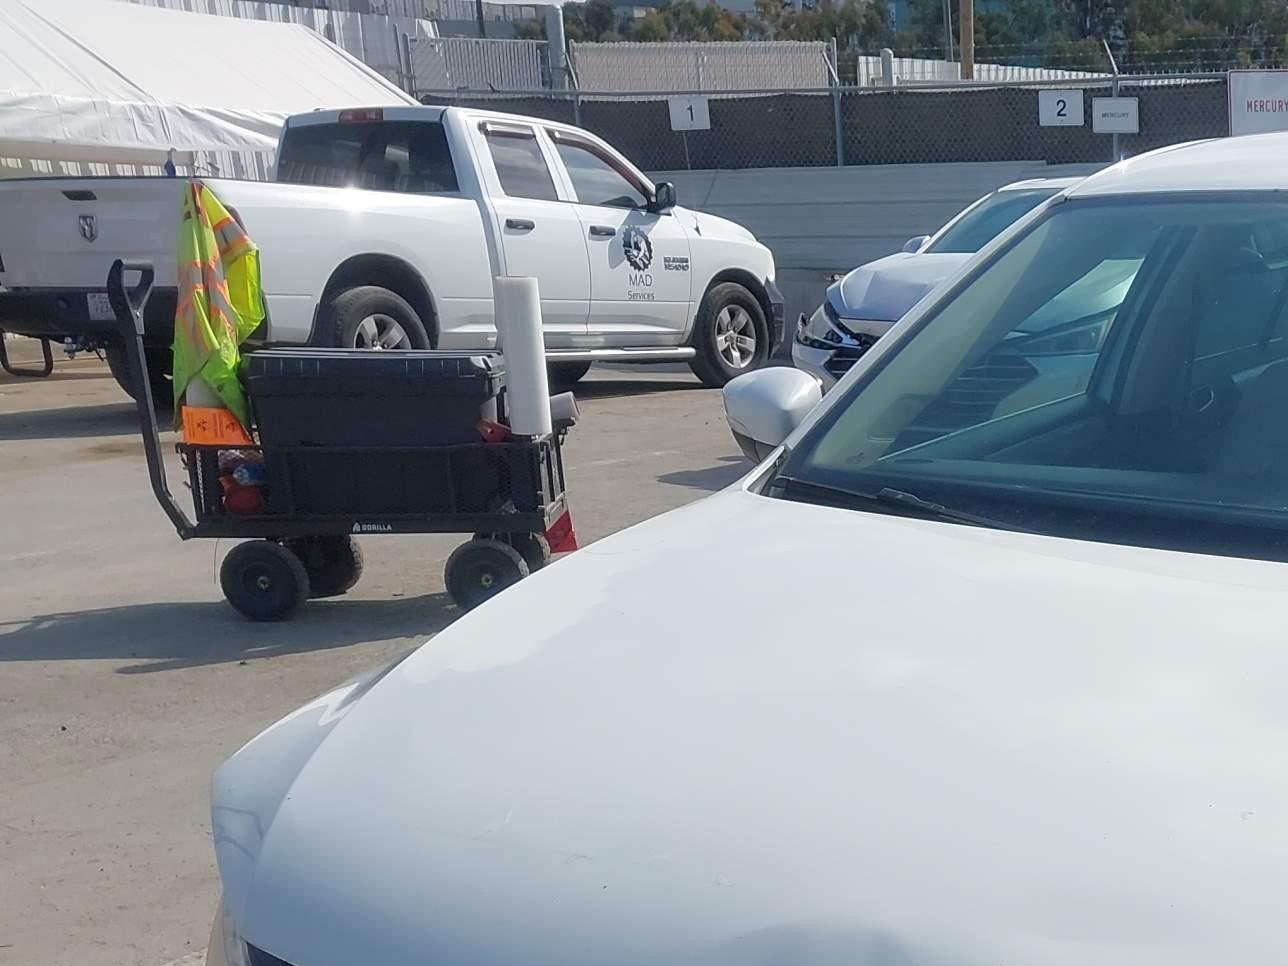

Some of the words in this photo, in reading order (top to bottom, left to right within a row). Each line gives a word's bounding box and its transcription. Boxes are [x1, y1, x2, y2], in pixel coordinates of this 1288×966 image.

[687, 104, 694, 121] 1
[1056, 99, 1067, 117] 2
[629, 273, 653, 287] MAD
[627, 290, 655, 300] Services
[361, 523, 393, 531] GORILLA
